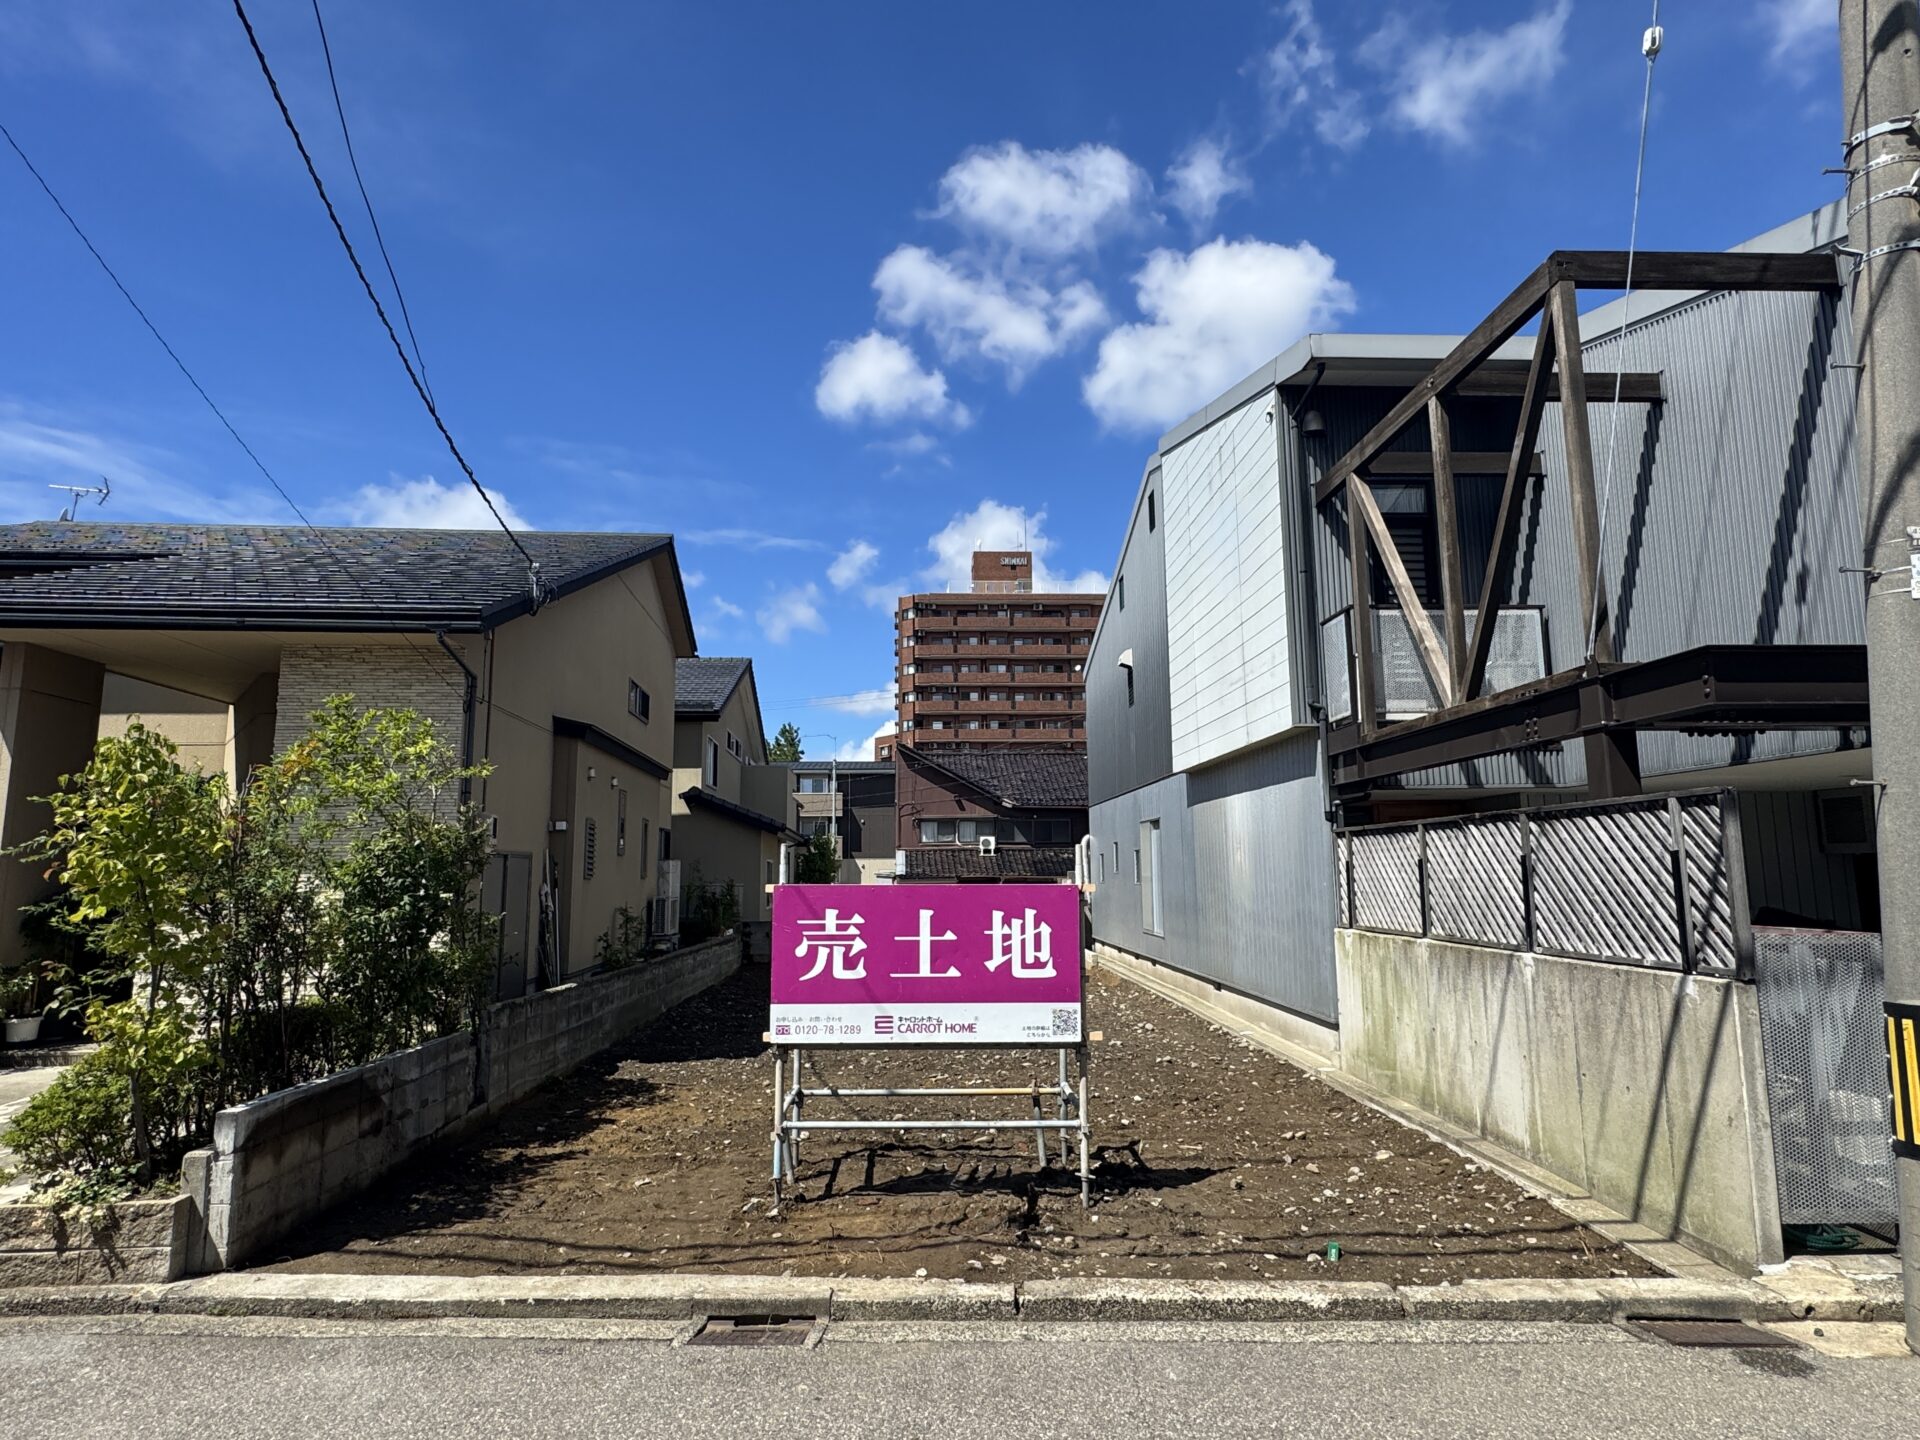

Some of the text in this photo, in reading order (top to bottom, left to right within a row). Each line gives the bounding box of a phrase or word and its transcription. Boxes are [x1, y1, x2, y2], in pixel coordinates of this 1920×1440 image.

[795, 908, 1057, 981] 売土地
[795, 1025, 861, 1035] 0120-78-1289
[897, 1023, 977, 1034] CARROT HOME
